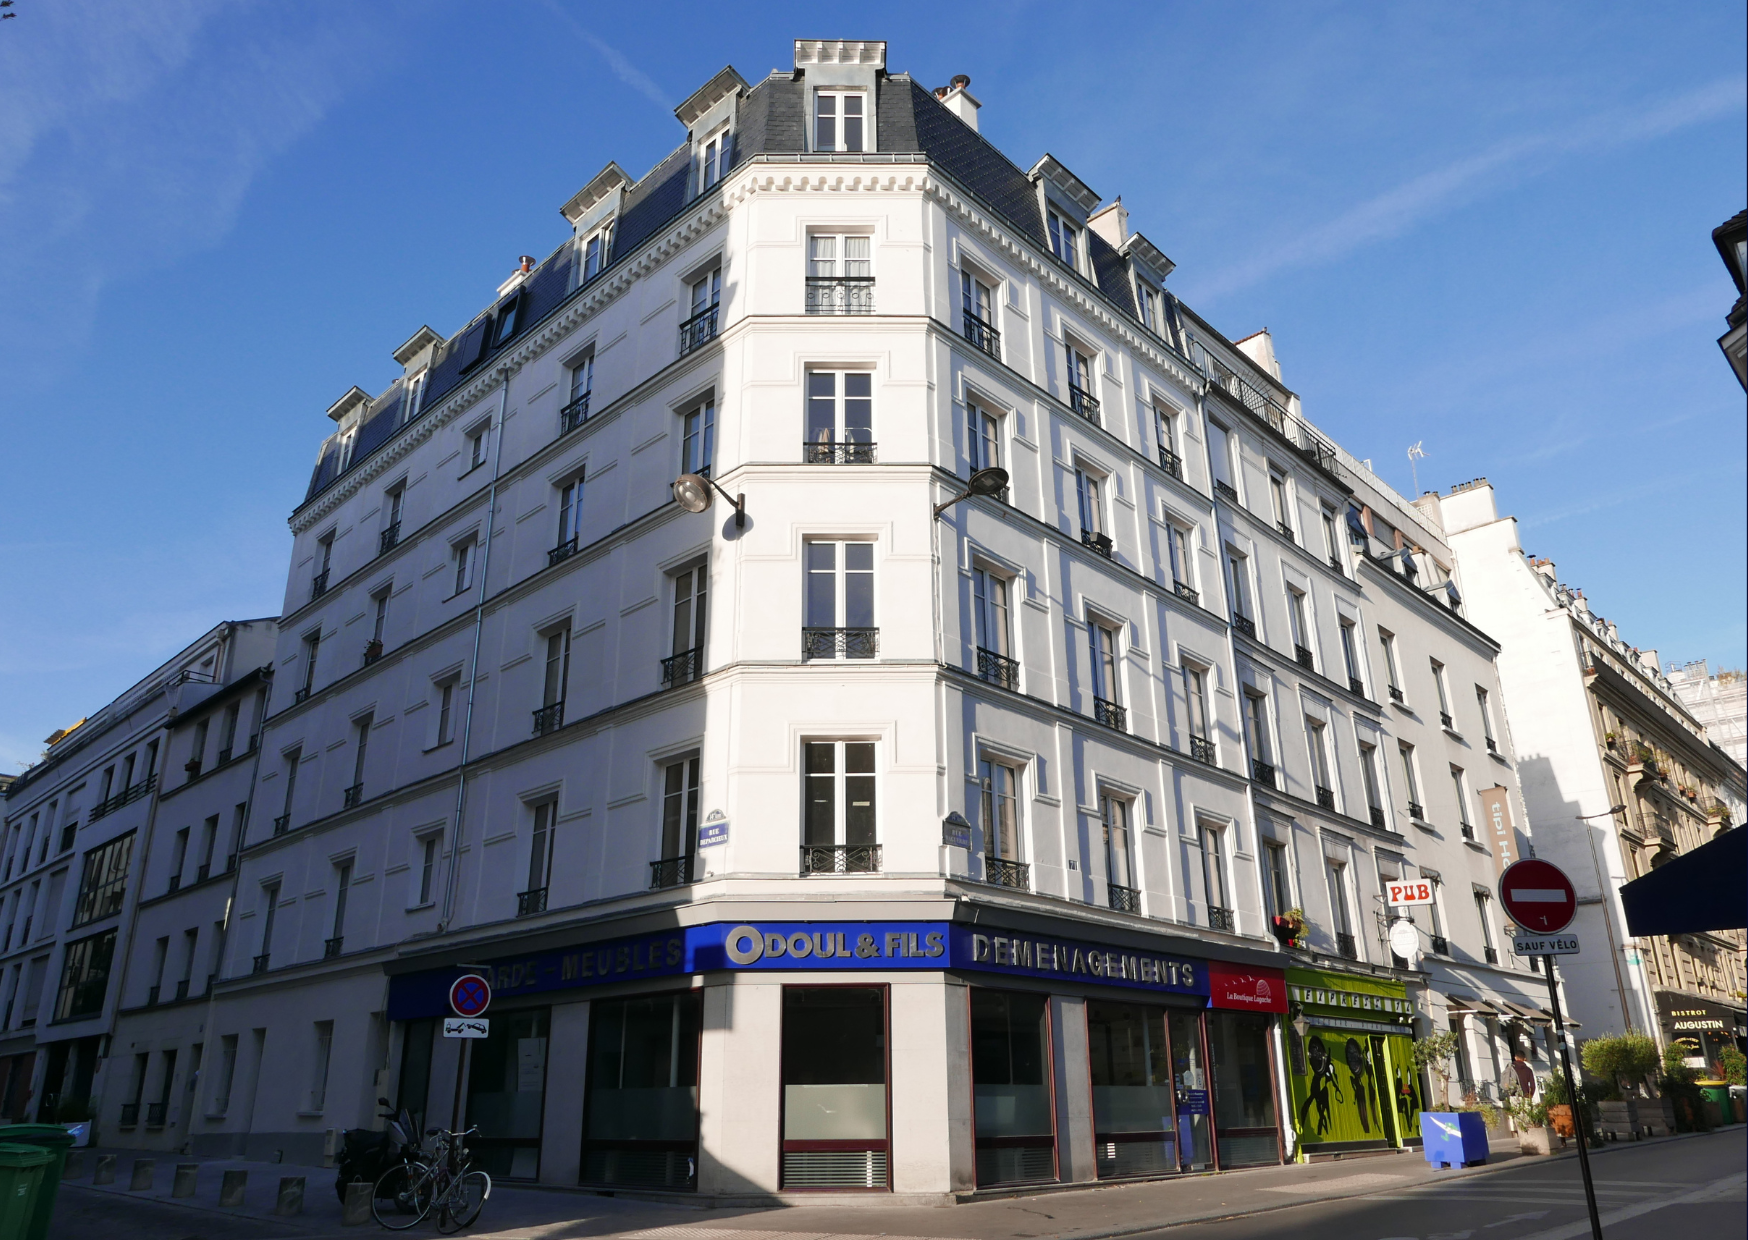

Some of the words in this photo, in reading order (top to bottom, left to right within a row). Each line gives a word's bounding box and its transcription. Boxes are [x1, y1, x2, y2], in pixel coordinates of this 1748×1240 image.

[1492, 802, 1506, 835] tipi
[708, 828, 720, 836] RUE
[1390, 884, 1430, 902] PUB
[725, 925, 852, 965] ODOUL
[855, 933, 882, 958] &
[885, 932, 944, 958] FILS
[1516, 941, 1546, 951] SAUF
[1549, 939, 1577, 950] VÉLO
[560, 938, 682, 981] MEUBLES
[972, 933, 1195, 987] DEMENAGEMENTS
[1226, 991, 1233, 1000] La
[1233, 992, 1254, 1003] Boutique
[1306, 989, 1381, 1008] EXPRESS
[1671, 1009, 1707, 1017] BISTROT
[1674, 1020, 1724, 1030] AUGUSTIN
